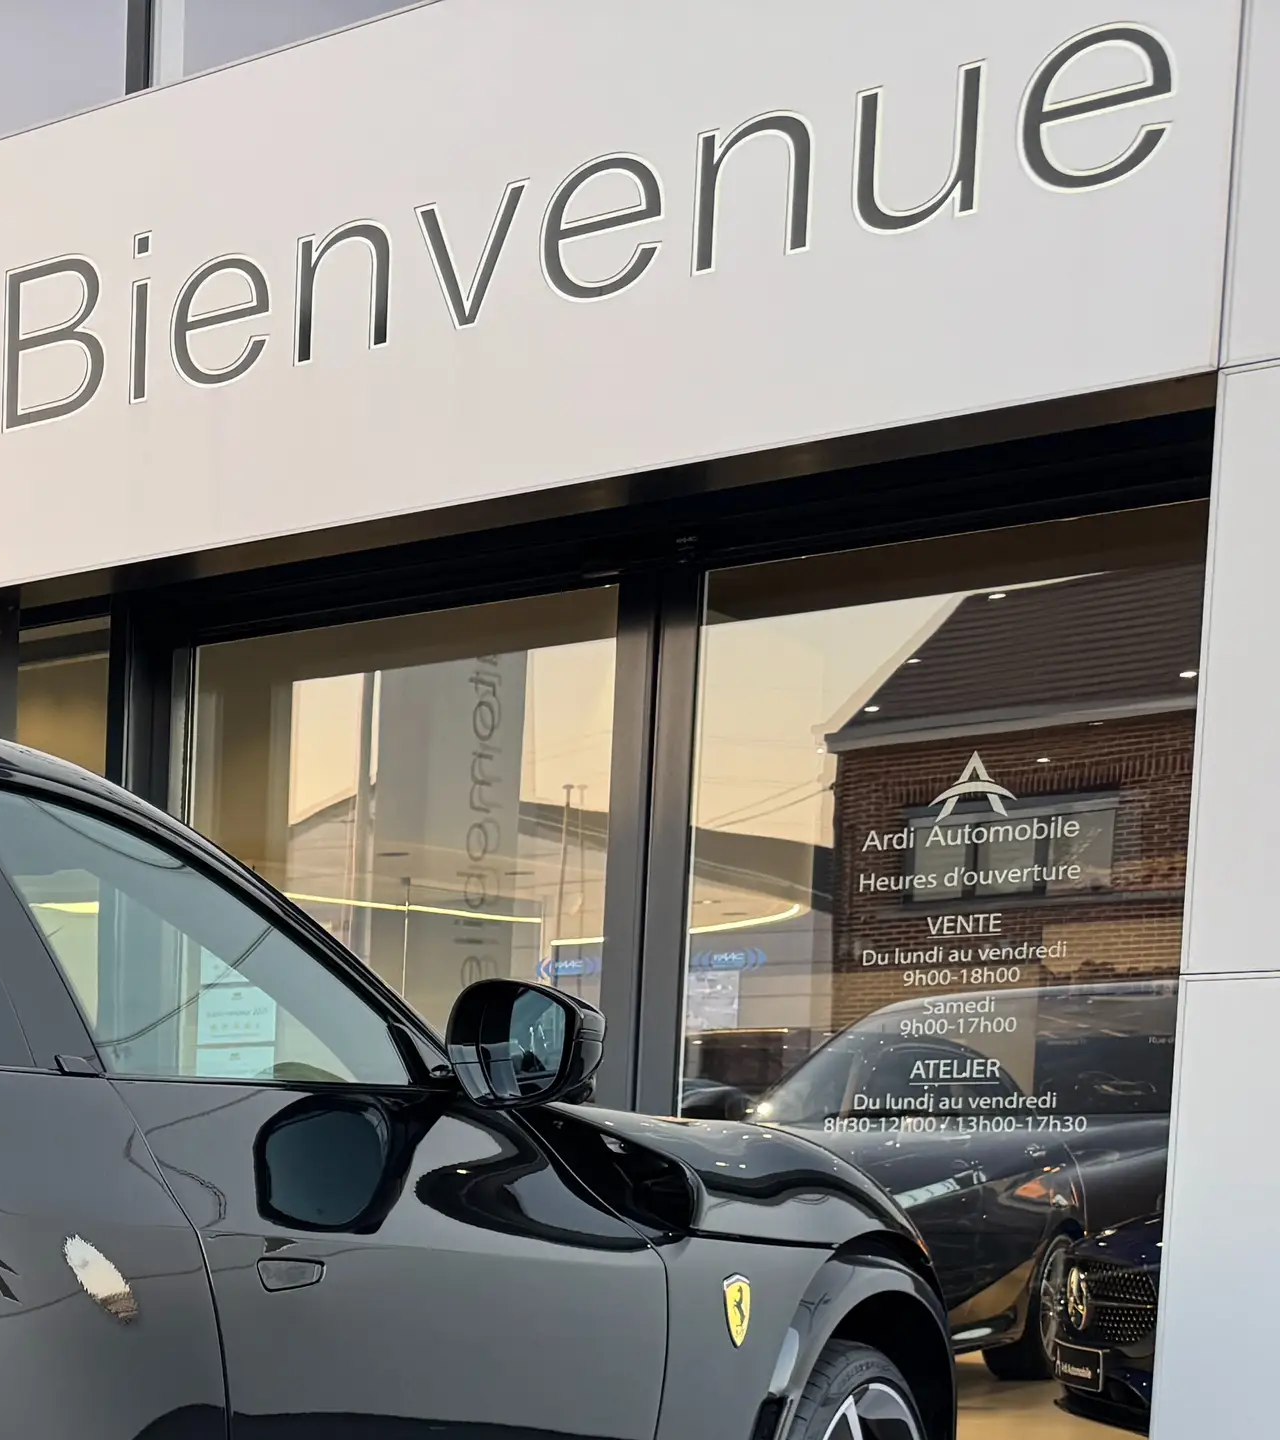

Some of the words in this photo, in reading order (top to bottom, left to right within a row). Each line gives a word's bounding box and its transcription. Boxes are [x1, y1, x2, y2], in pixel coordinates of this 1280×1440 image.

[3, 21, 1177, 432] Bienvenue
[862, 827, 915, 851] Ardi
[925, 816, 1081, 847] Automobile
[859, 873, 937, 892] Heures
[944, 864, 1081, 887] d'ouverture
[927, 913, 1002, 935] VENTE
[862, 950, 889, 966] Du
[894, 947, 943, 965] lundi
[948, 949, 972, 962] au
[978, 941, 1067, 961] vendredi
[903, 967, 1020, 987] 9h00-18h00
[923, 997, 995, 1015] Samedi
[900, 1017, 1017, 1036] 9h00-17h00
[910, 1059, 1000, 1079] ATELIER
[854, 1094, 880, 1110] Du
[886, 1093, 934, 1110] lundi
[939, 1097, 963, 1109] au
[969, 1092, 1057, 1109] vendredi
[824, 1117, 937, 1133] 8h30-12h00
[961, 1116, 1087, 1133] 13h00-17h30
